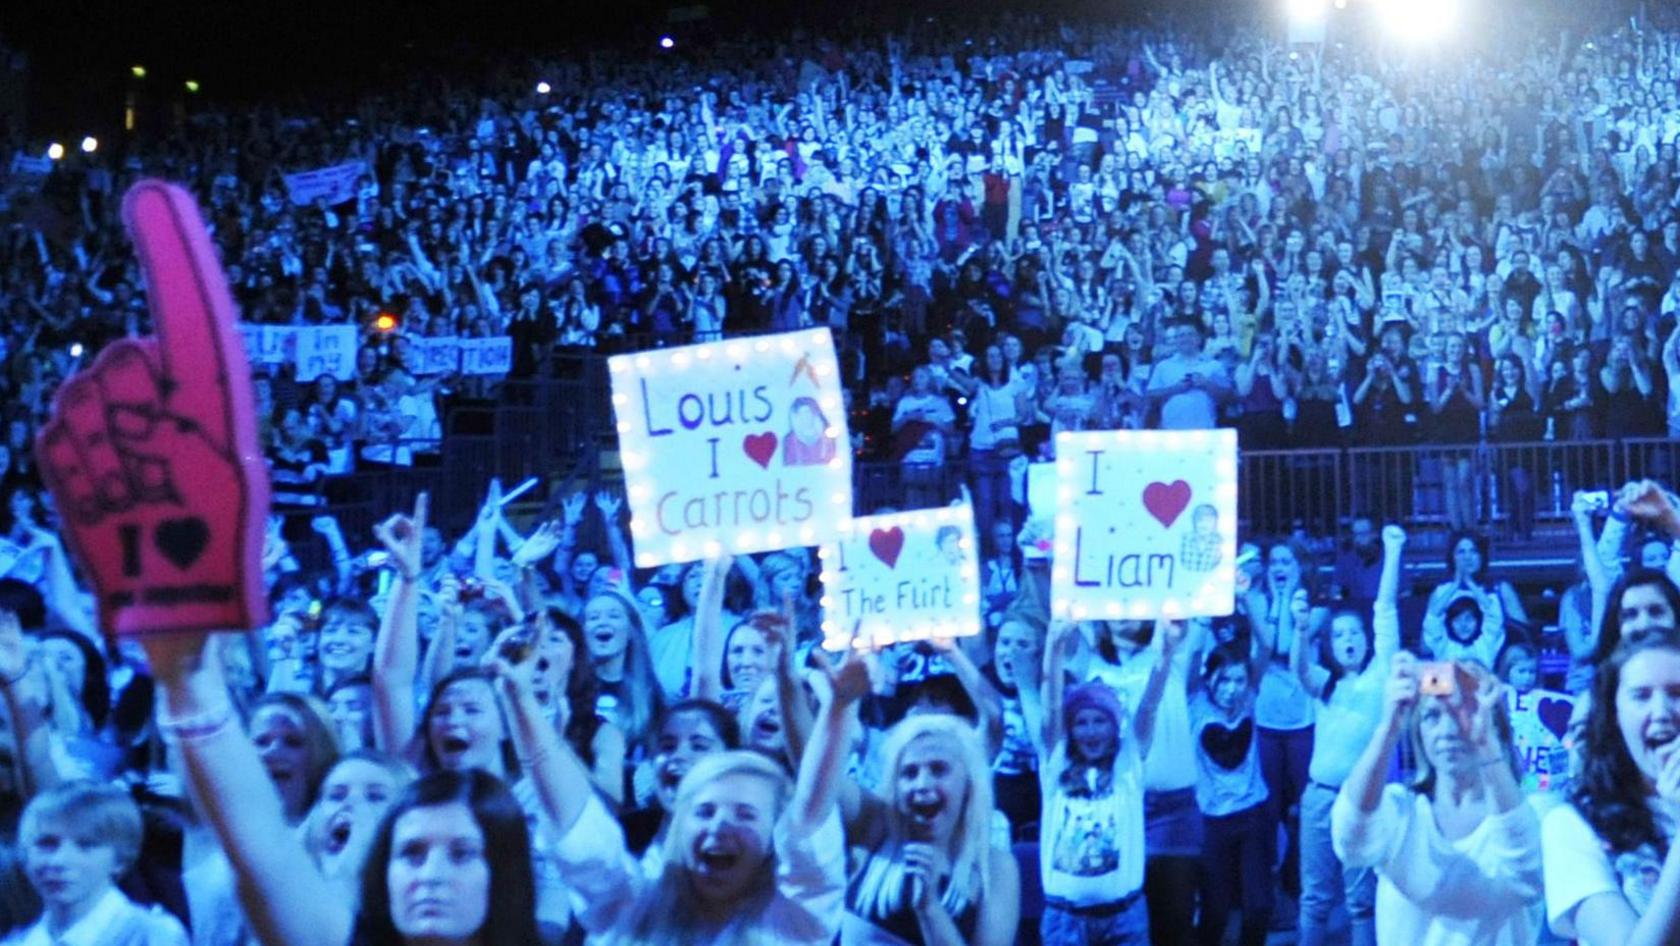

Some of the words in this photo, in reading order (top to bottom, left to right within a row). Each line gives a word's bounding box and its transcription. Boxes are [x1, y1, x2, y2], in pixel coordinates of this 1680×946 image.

[640, 364, 773, 437] Louis
[706, 437, 720, 479] I
[1084, 450, 1105, 495] I
[656, 478, 813, 535] Carrots
[838, 540, 848, 572] I
[1074, 525, 1175, 588] Liam
[841, 588, 886, 617] The
[897, 575, 953, 610] Flirt
